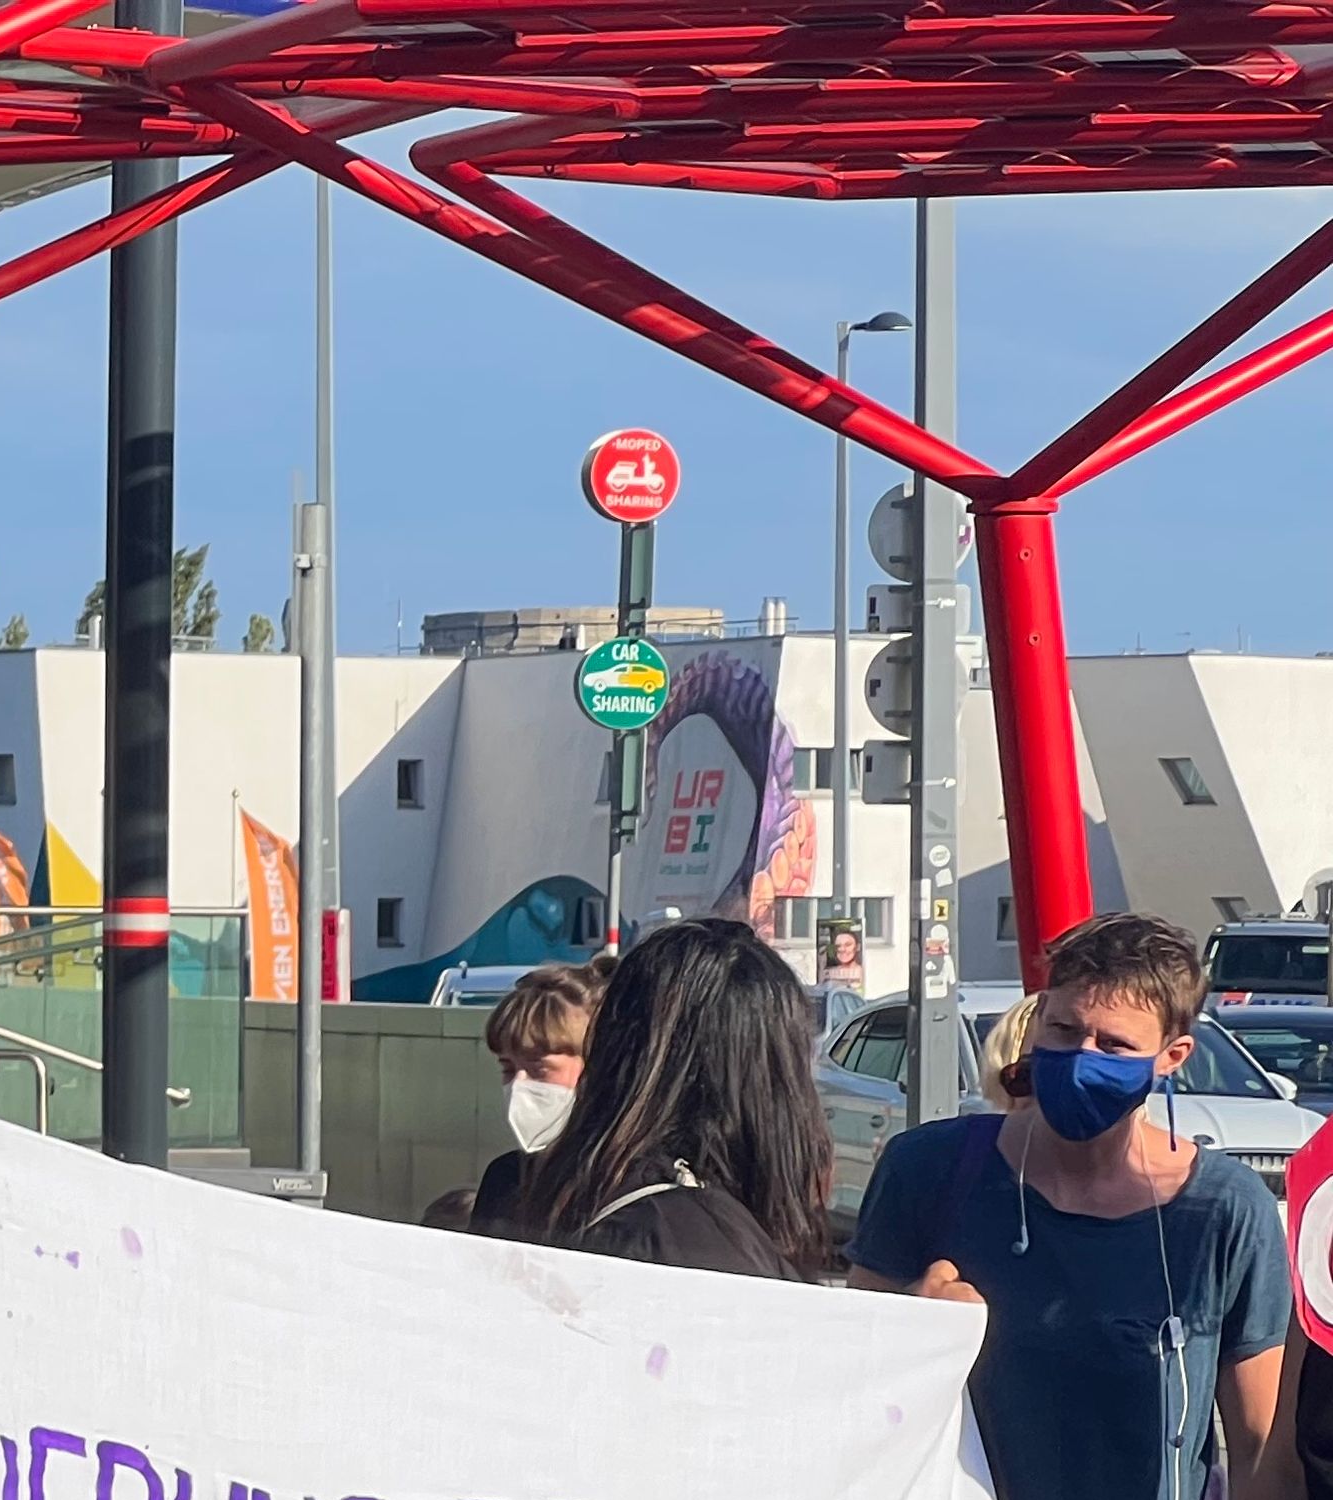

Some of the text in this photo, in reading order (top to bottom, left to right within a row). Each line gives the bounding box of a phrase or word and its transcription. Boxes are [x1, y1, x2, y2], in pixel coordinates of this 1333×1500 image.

[615, 438, 662, 452] MOPED
[605, 494, 664, 508] SHARING
[612, 643, 640, 661] CAR
[592, 695, 656, 714] SHARING
